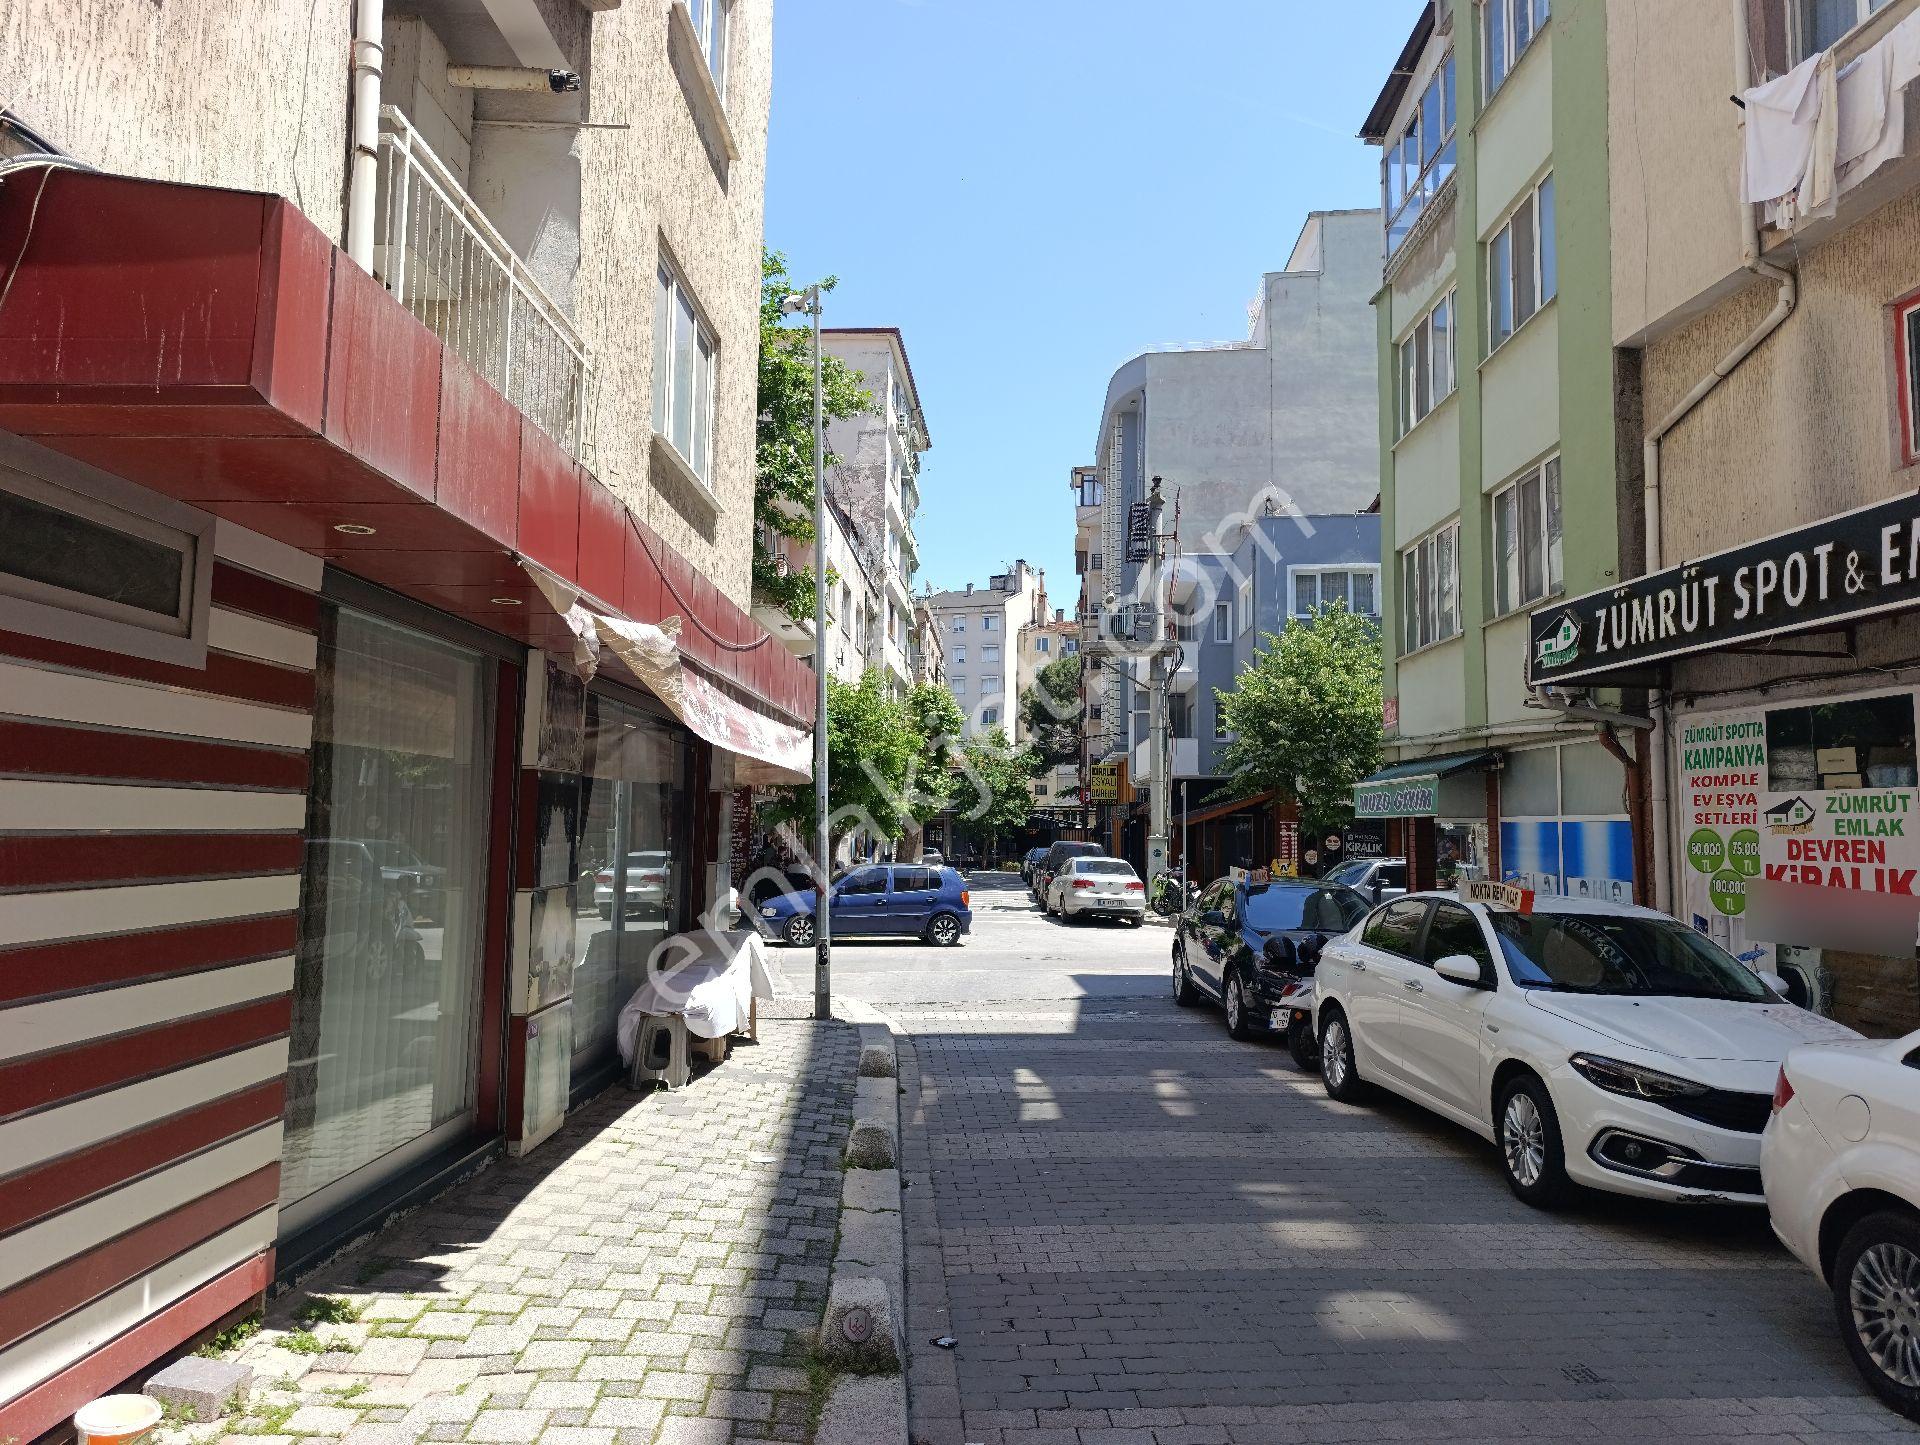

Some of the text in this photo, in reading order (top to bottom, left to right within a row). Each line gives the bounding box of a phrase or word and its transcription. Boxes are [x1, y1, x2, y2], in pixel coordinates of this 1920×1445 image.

[1595, 566, 1719, 652] ZÜMRÜT
[1734, 541, 1834, 620] SPOT
[1844, 550, 1865, 594] &
[1685, 722, 1764, 744] ZÜMRÜT SPOTTA
[1685, 743, 1764, 770] KAMPANYA
[1690, 773, 1758, 787] KOMPLE
[1693, 793, 1757, 808] EV EŞYA
[1826, 791, 1911, 813] ZÜMRÜT
[1694, 809, 1757, 824] SETLERİ
[1834, 819, 1904, 836] EMLAK
[1691, 842, 1721, 856] 50.000
[1787, 839, 1885, 864] DEVREN
[1702, 860, 1711, 872] TL
[1744, 860, 1754, 873] TL
[1470, 883, 1490, 899] NOKTA
[1725, 897, 1734, 910] TL
